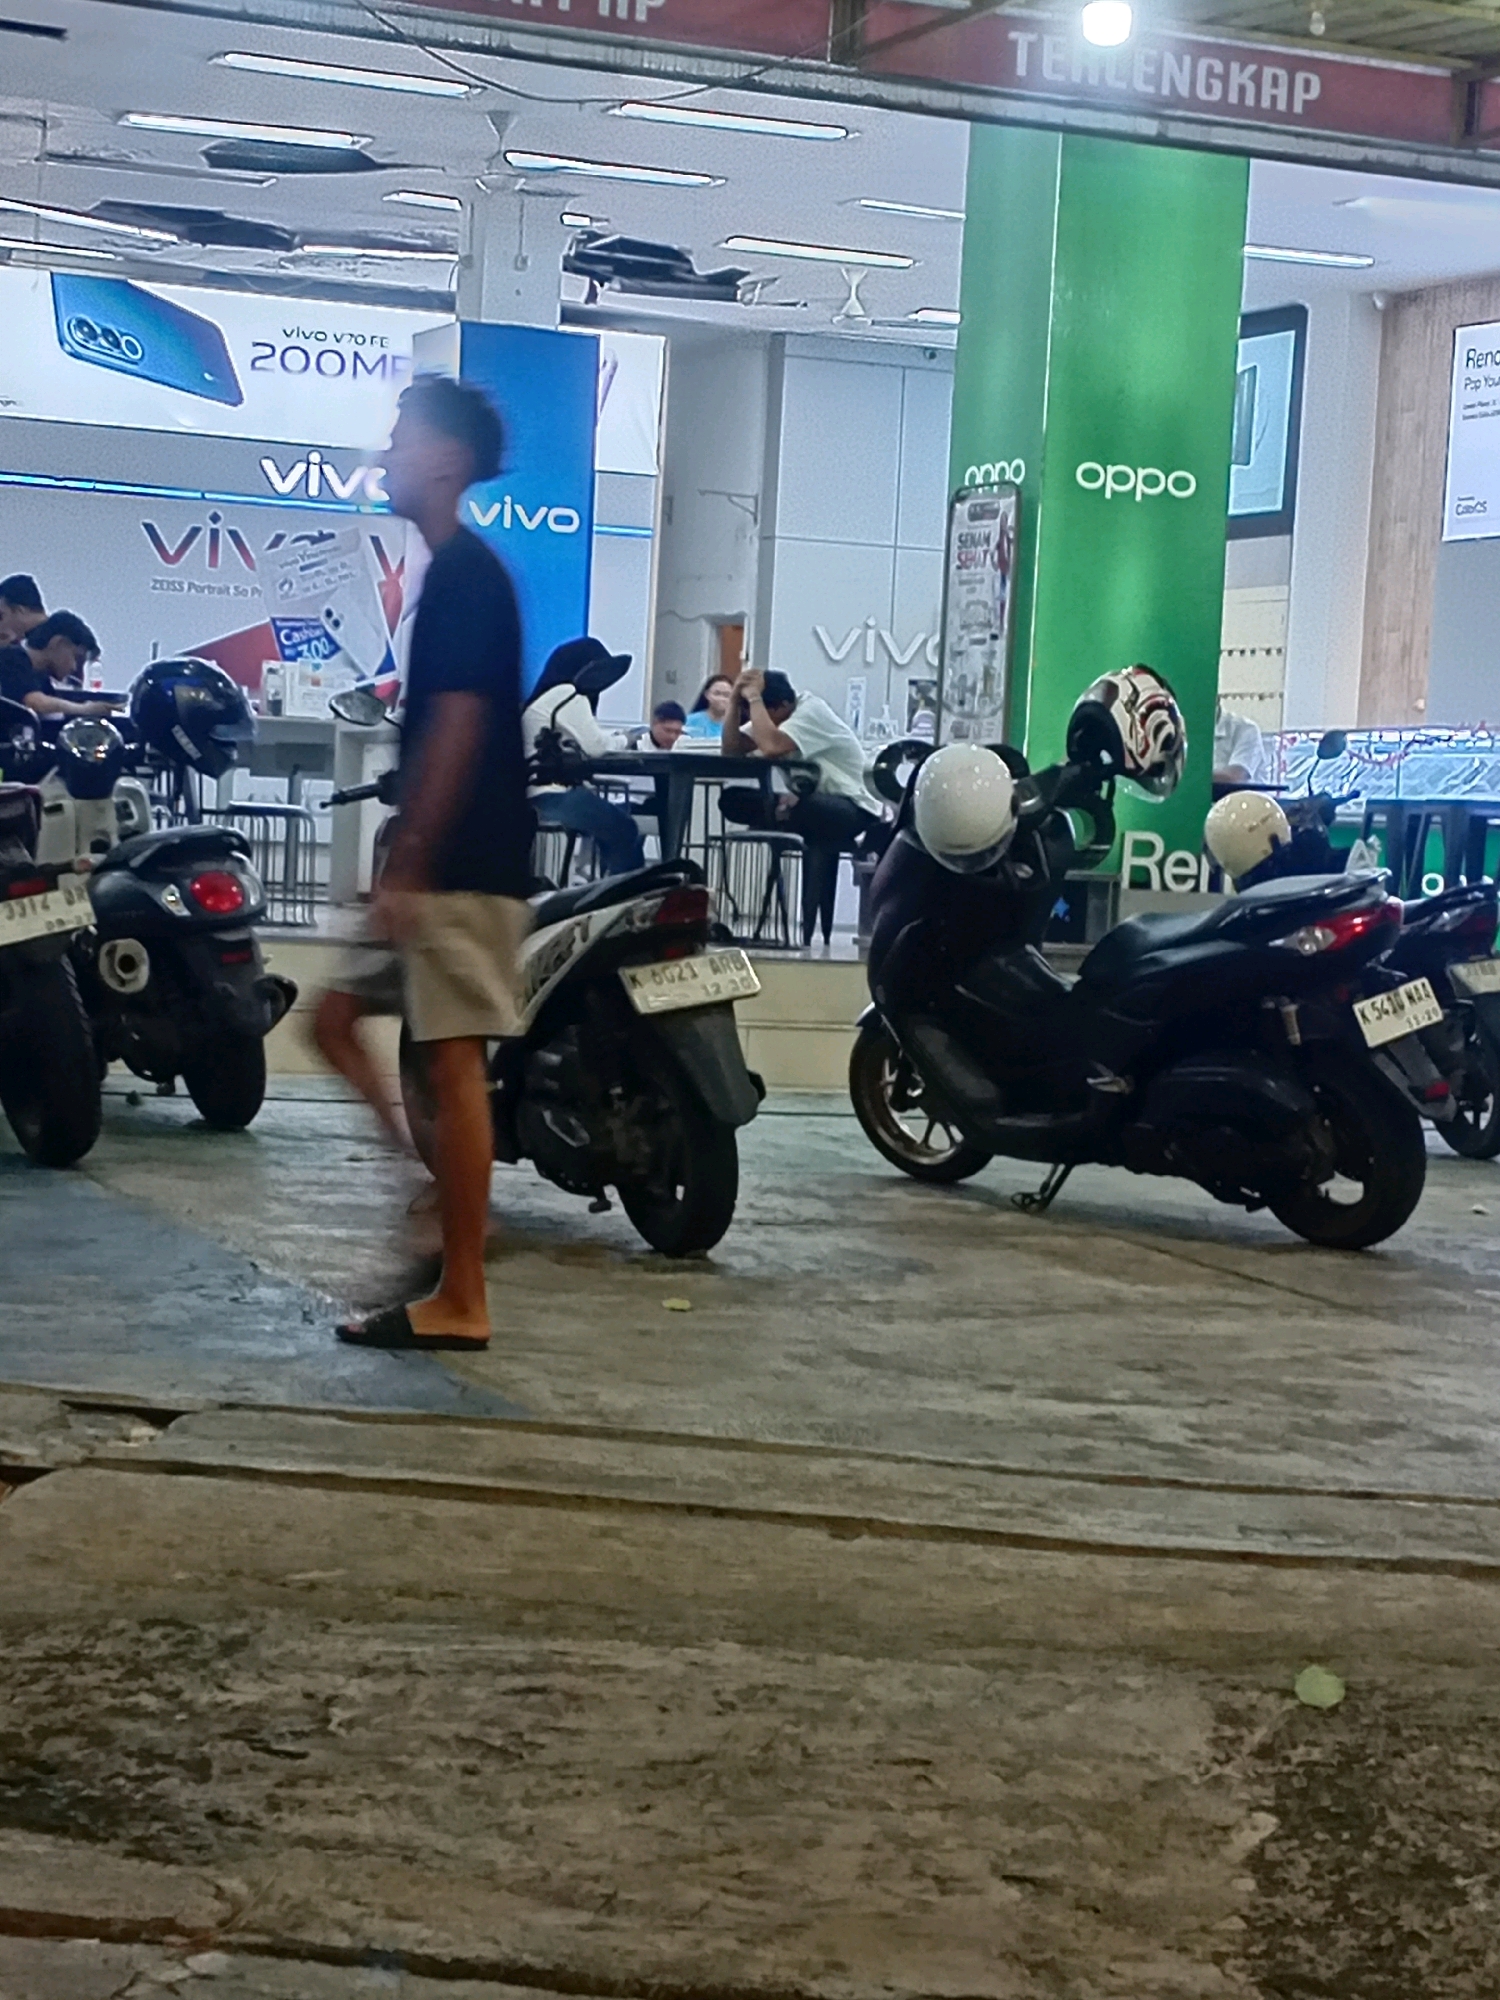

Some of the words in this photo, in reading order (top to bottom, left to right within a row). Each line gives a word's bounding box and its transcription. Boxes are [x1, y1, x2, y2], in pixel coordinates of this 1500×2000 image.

[282, 326, 328, 342] vivo
[1075, 461, 1197, 502] oppo
[468, 494, 580, 534] vivo
[628, 974, 643, 990] K
[1358, 1006, 1371, 1026] K
